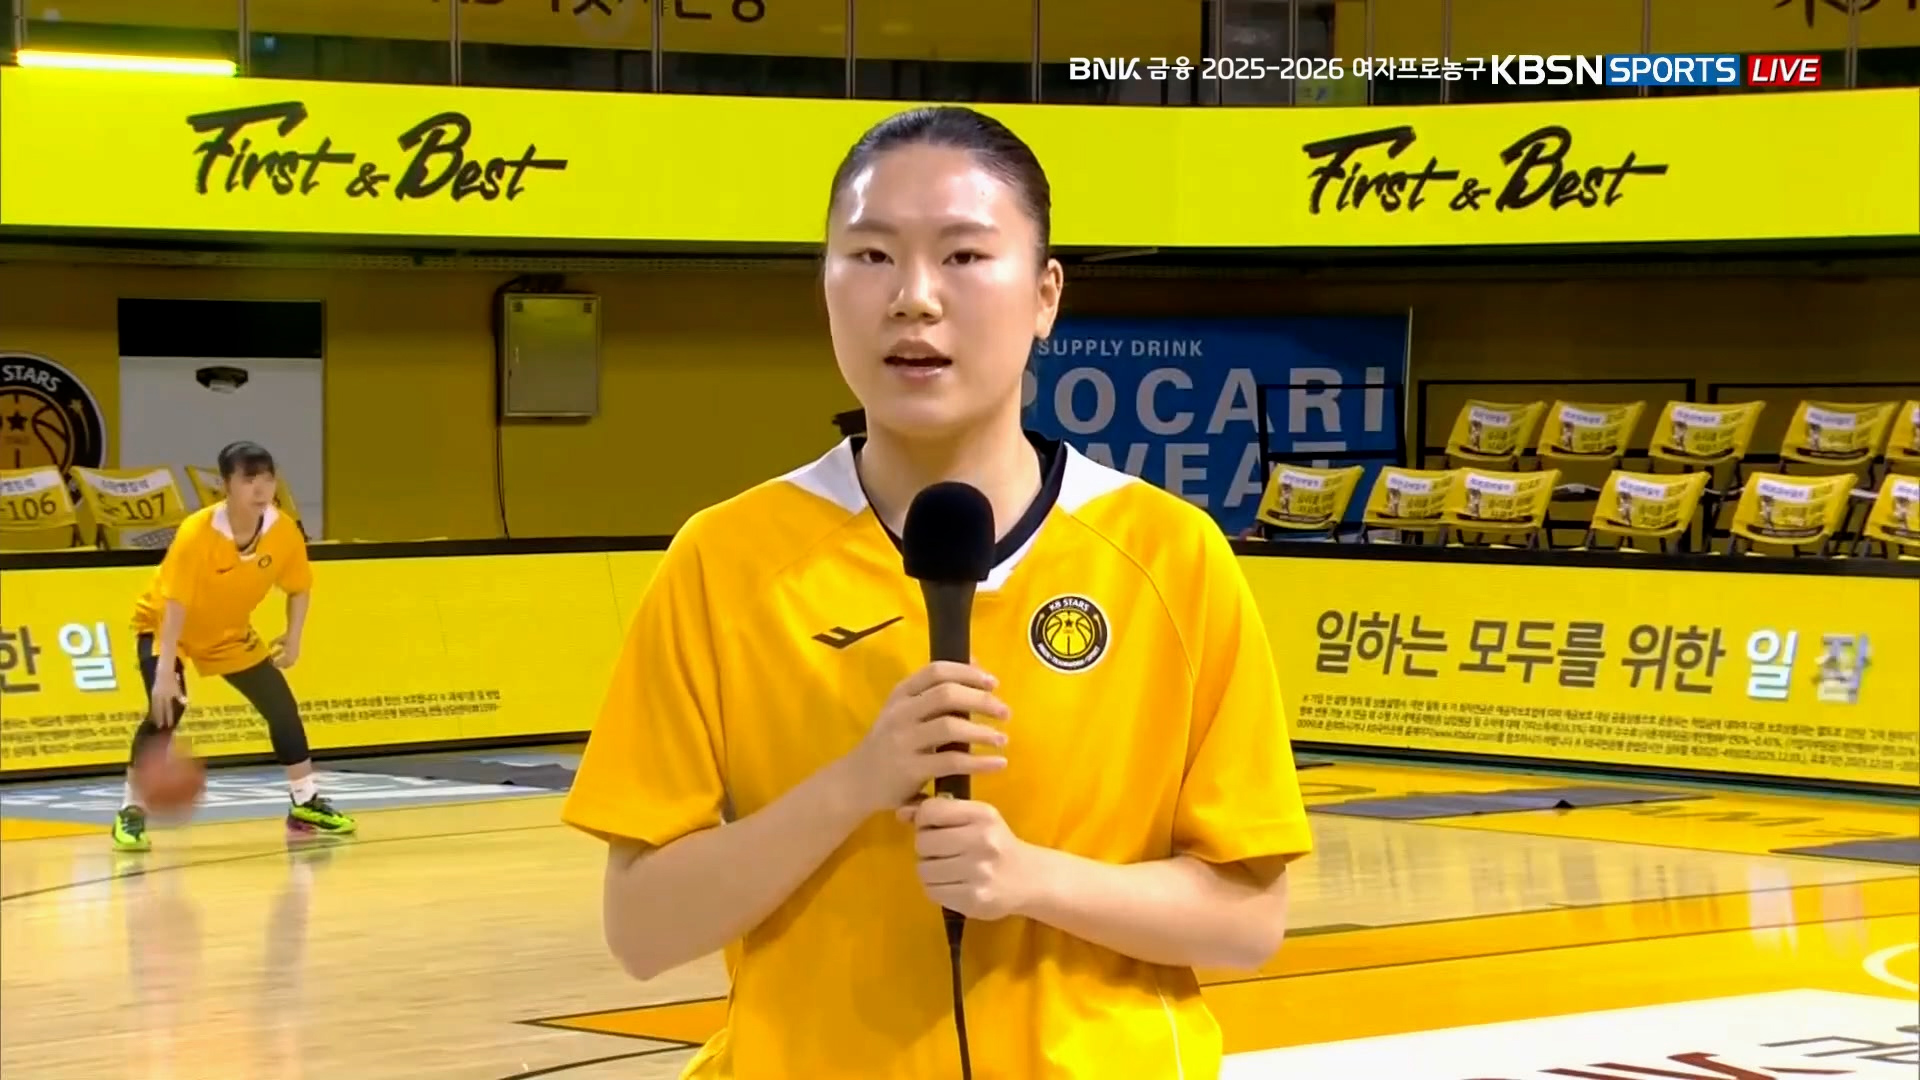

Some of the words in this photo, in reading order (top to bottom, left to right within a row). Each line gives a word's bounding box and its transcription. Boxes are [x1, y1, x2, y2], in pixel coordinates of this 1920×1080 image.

[187, 101, 355, 196] First
[346, 162, 390, 198] &
[394, 111, 568, 202] Best
[1302, 125, 1460, 215] First
[1448, 177, 1492, 211] &
[1495, 125, 1669, 213] Best
[2, 364, 62, 392] STARS
[1038, 340, 1123, 356] SUPPLY
[1131, 340, 1203, 356] DRINK
[1063, 598, 1089, 611] STARS
[58, 621, 118, 691] 일
[1315, 609, 1447, 677] 일하는
[1458, 620, 1606, 688] 모두를
[1621, 623, 1726, 694] 위한
[1746, 629, 1798, 701] 일
